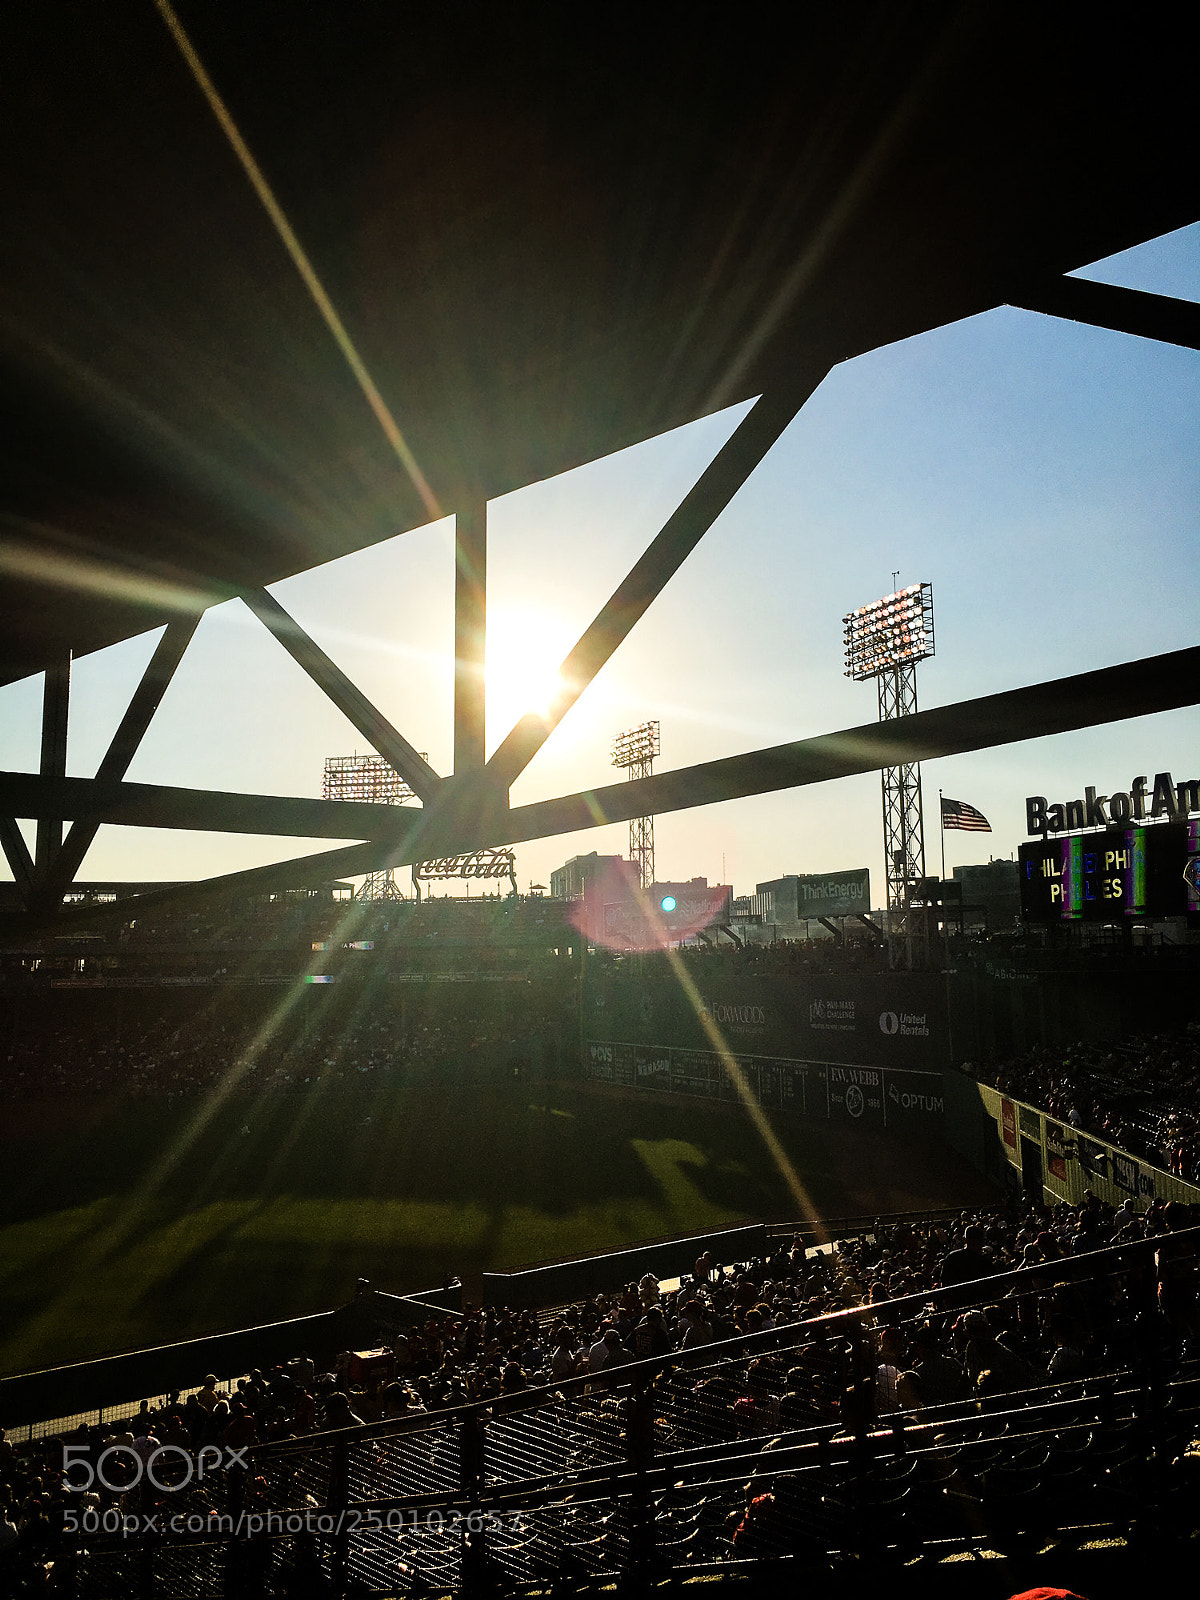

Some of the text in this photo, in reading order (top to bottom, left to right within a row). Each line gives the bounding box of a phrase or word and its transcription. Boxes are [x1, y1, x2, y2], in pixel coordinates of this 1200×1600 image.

[1026, 786, 1110, 836] Bank
[1110, 776, 1149, 823] of
[712, 1002, 765, 1025] FOXWOODS
[899, 1013, 926, 1025] United
[899, 1023, 930, 1036] Rentals
[597, 1046, 613, 1062] CVS
[849, 1069, 879, 1087] WEBB
[901, 1093, 944, 1112] OPTUM
